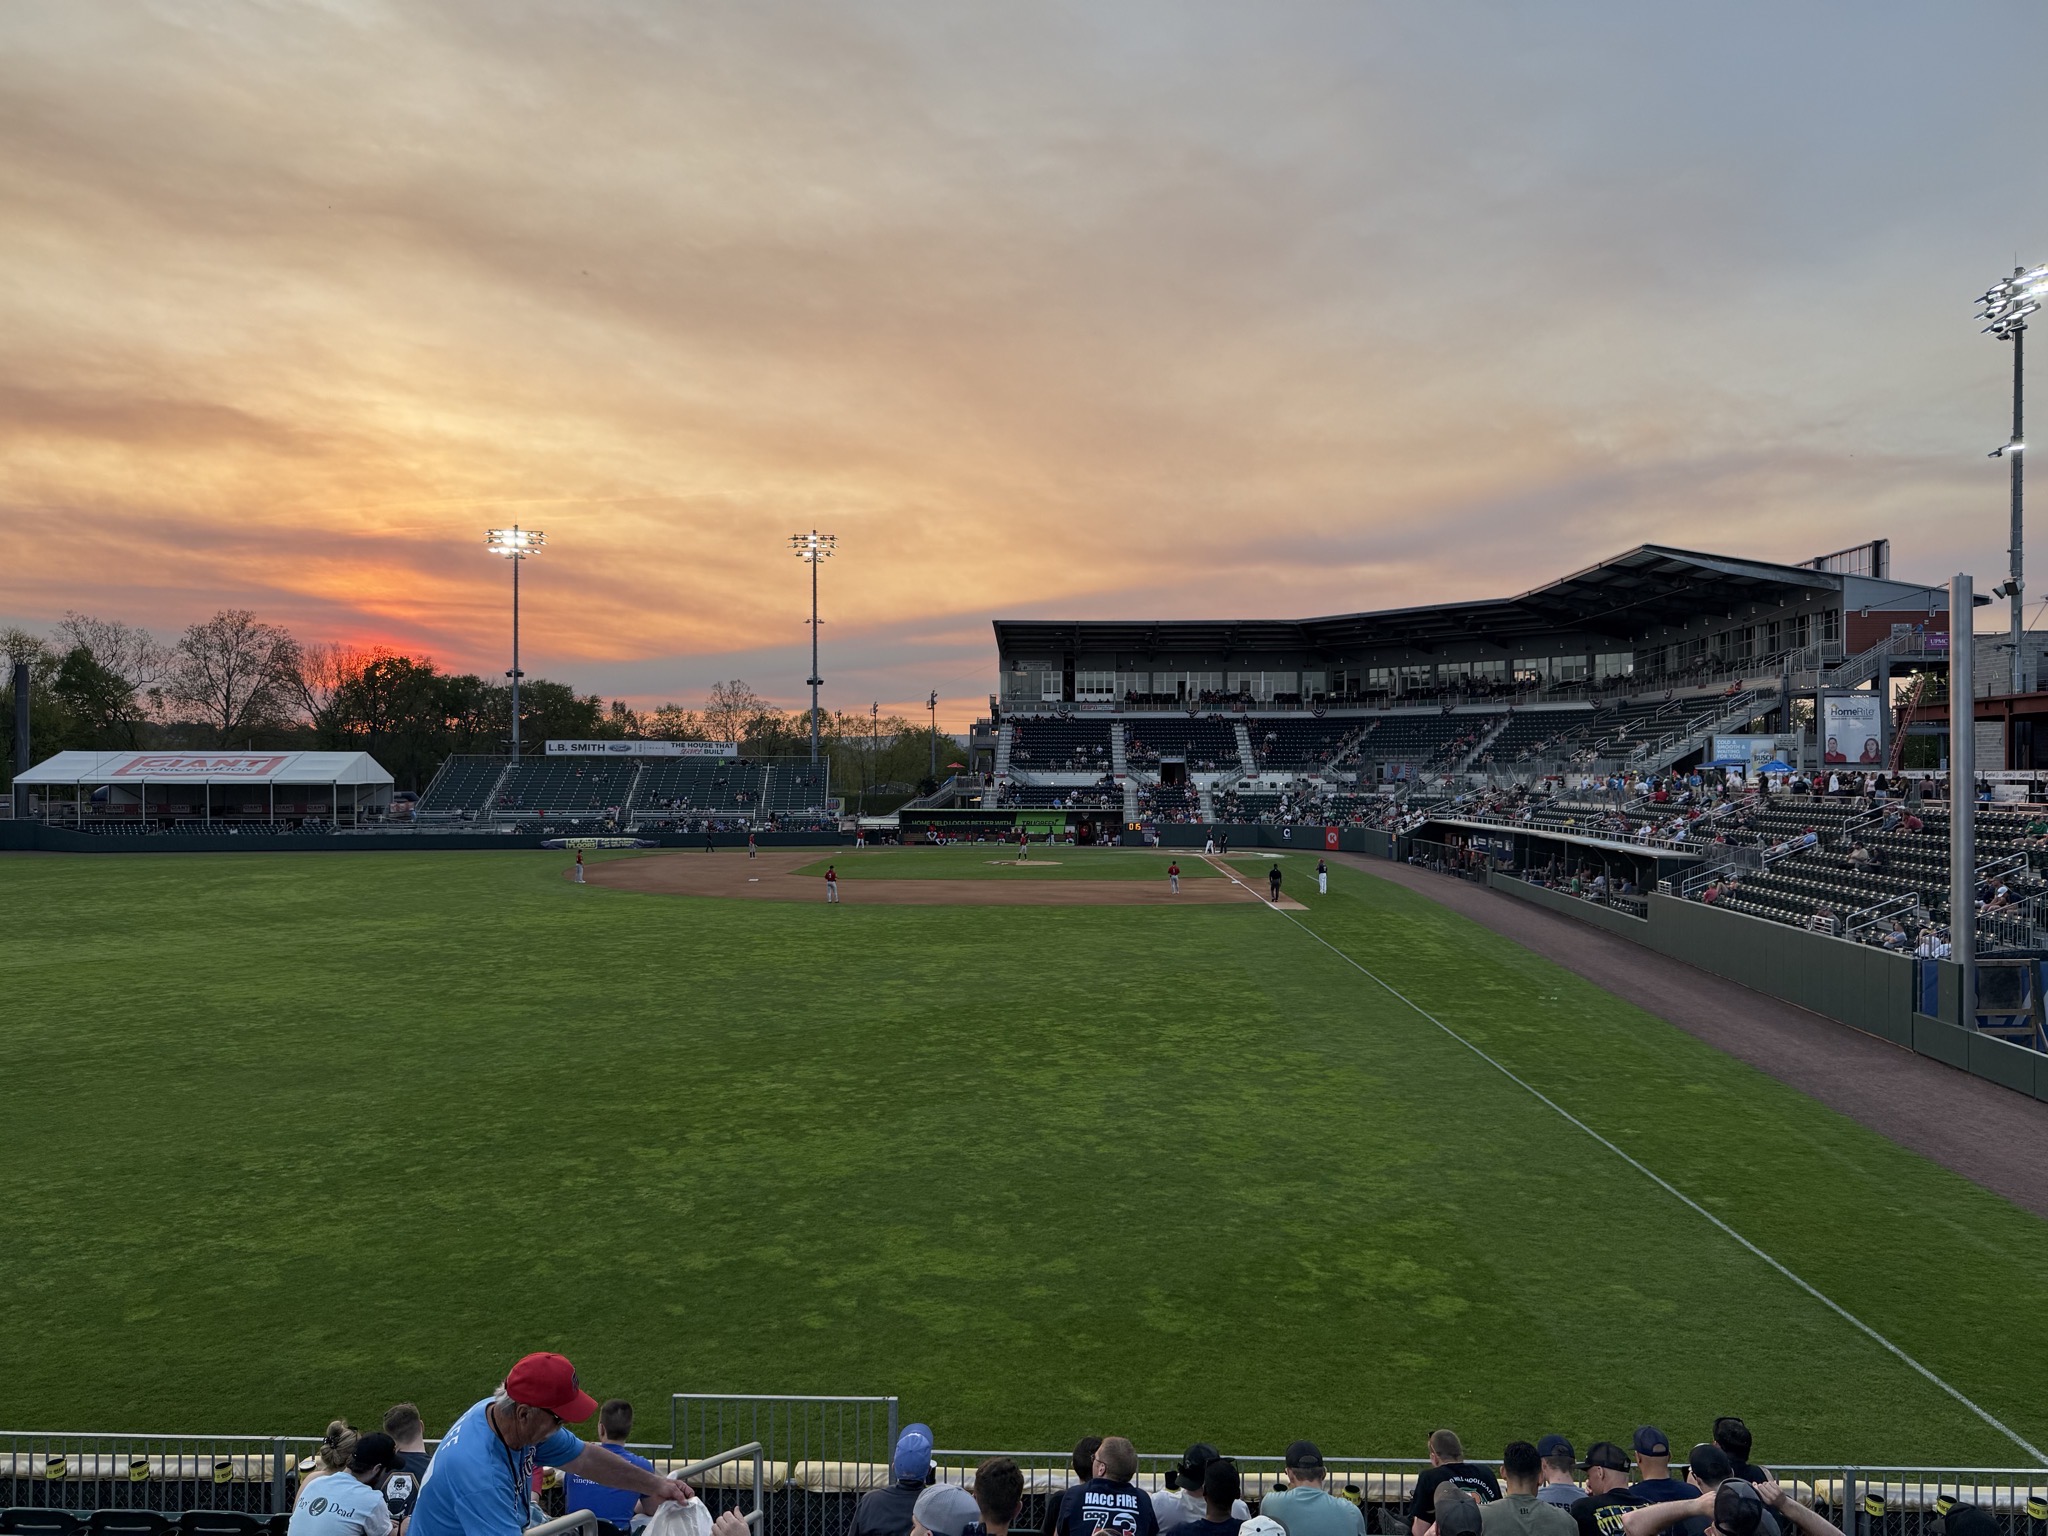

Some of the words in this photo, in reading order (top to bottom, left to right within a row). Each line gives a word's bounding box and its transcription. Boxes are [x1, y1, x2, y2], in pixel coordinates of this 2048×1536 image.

[1830, 707, 1875, 716] HomeRite
[548, 743, 568, 752] L.B.
[570, 743, 606, 752] SMITH
[1754, 754, 1774, 762] BUSCH
[141, 759, 270, 768] GIANT
[1128, 822, 1142, 831] 06
[1085, 1492, 1115, 1507] HACC
[1116, 1494, 1139, 1509] FIRE
[328, 1502, 356, 1518] Dead
[1083, 1511, 1138, 1536] 73
